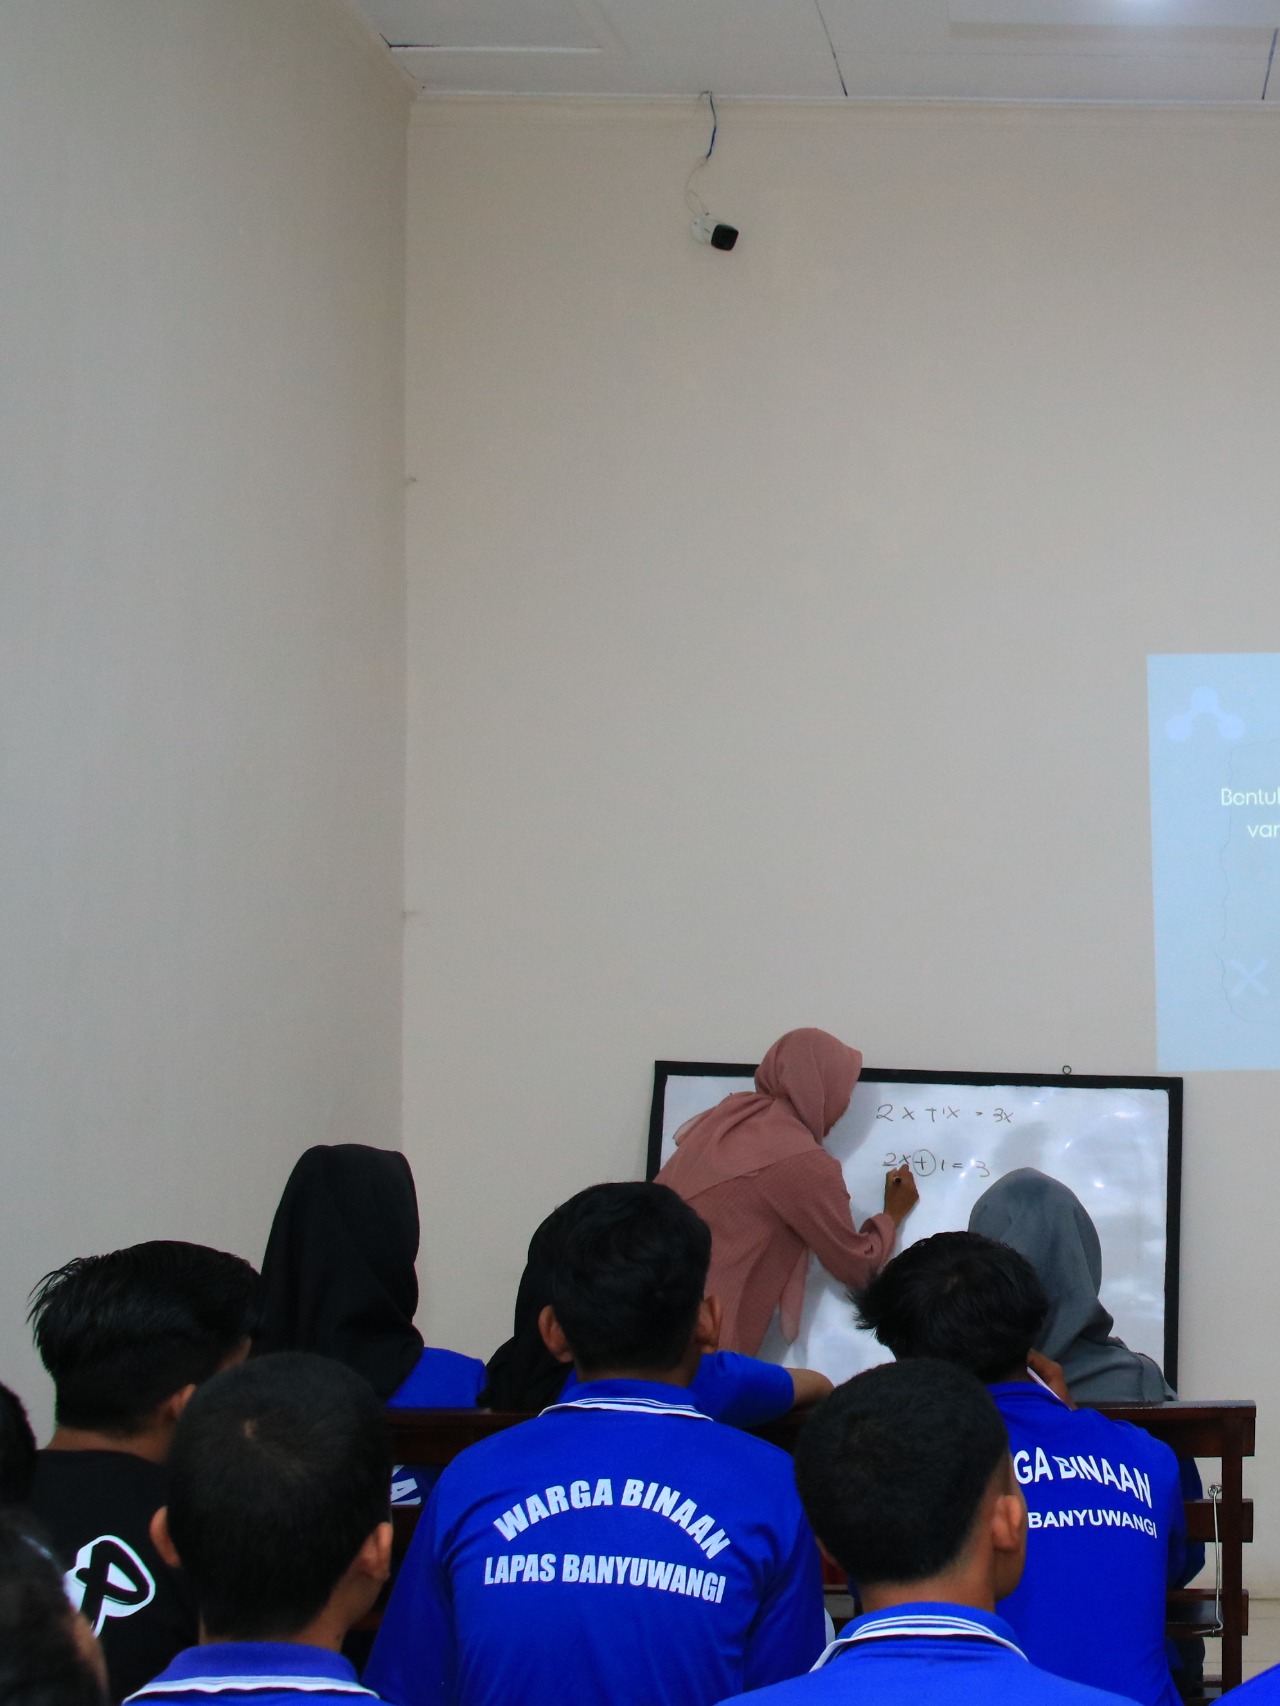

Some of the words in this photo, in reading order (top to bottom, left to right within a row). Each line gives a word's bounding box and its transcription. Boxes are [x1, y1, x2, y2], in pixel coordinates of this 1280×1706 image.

[1052, 1455, 1152, 1508] BINAAN
[493, 1478, 614, 1542] WARGA
[620, 1478, 731, 1560] BINAAN
[1028, 1508, 1158, 1539] BANYUWANGI
[484, 1553, 557, 1585] LAPAS
[562, 1553, 727, 1604] BANYUWANGI
